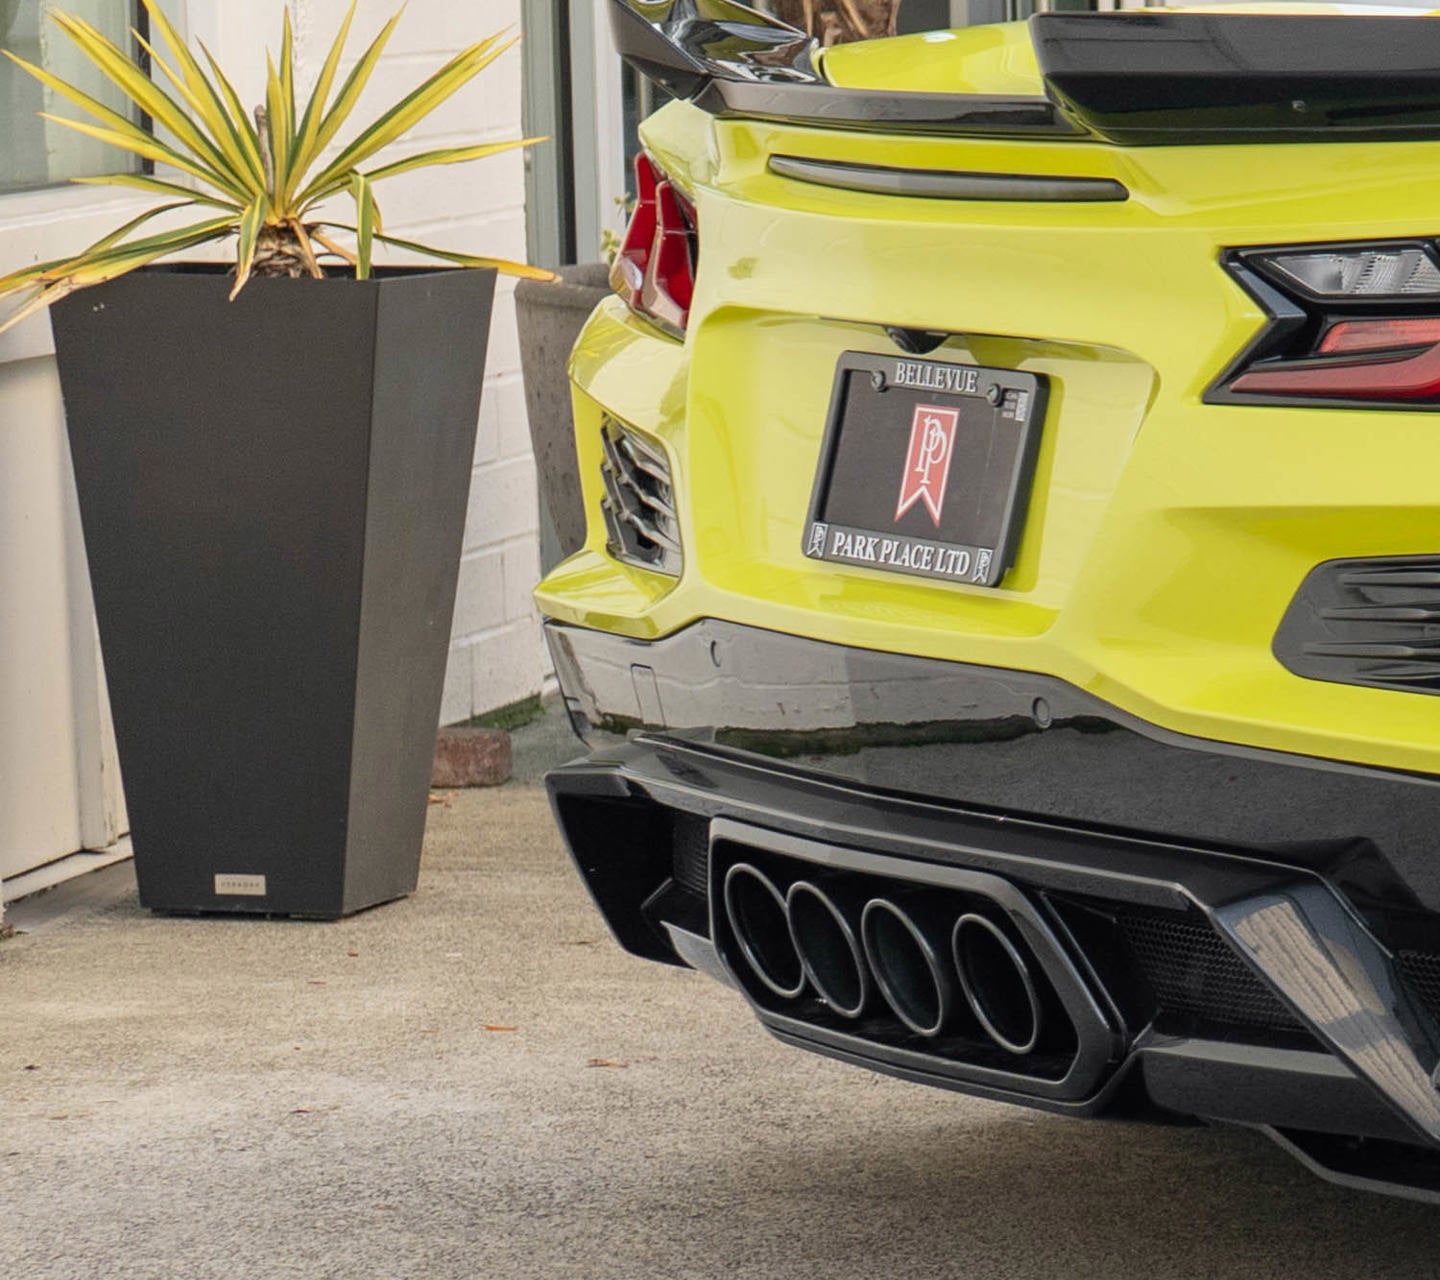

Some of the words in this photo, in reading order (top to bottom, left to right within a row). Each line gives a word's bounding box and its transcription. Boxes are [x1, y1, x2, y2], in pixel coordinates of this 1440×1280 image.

[894, 362, 978, 393] BELLEVUE
[831, 531, 878, 561] PARK
[880, 539, 935, 571] PLACE
[935, 548, 971, 576] LTD
